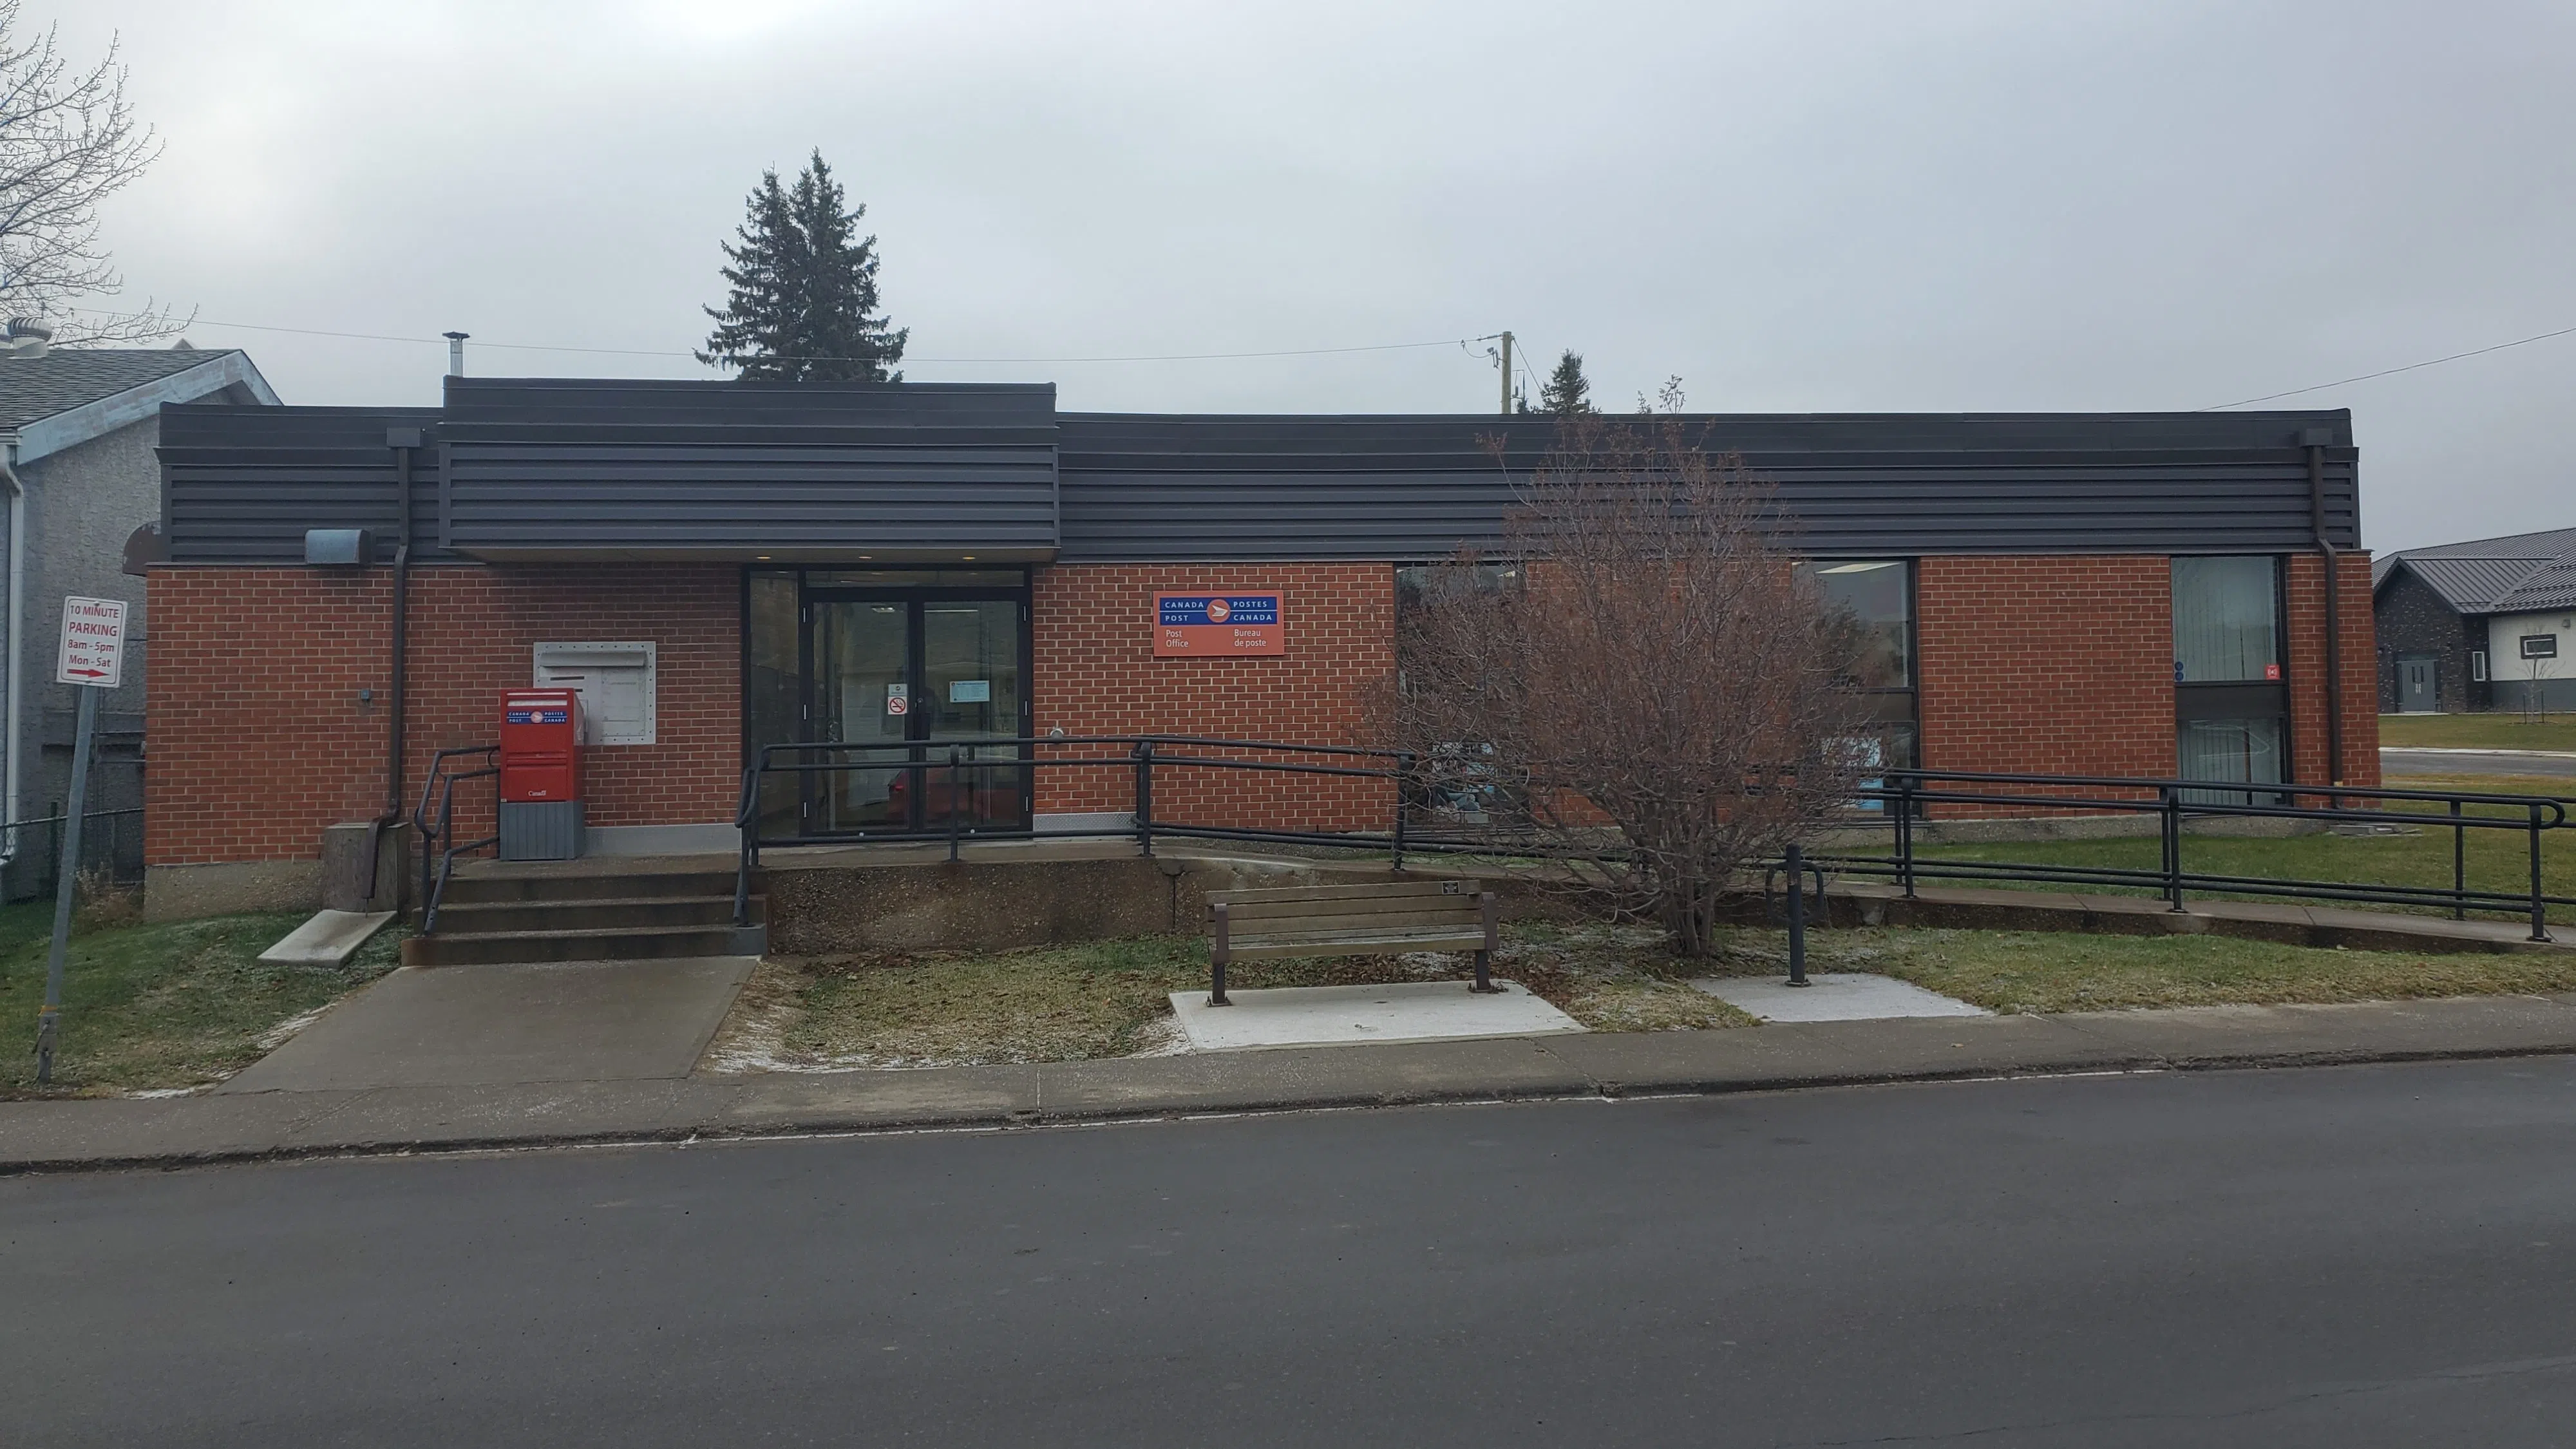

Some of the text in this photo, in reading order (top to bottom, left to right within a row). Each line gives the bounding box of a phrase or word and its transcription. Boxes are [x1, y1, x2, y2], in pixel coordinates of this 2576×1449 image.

[70, 605, 119, 618] 10 MINUTE
[68, 621, 117, 636] PARKING
[1166, 629, 1182, 638] Post
[1234, 629, 1261, 637] Bureau
[68, 639, 87, 650] 8am
[94, 641, 115, 654] 5pm
[1166, 639, 1189, 647] Office
[1234, 638, 1267, 649] de poste
[68, 654, 89, 665] Mon
[96, 657, 111, 667] Sat
